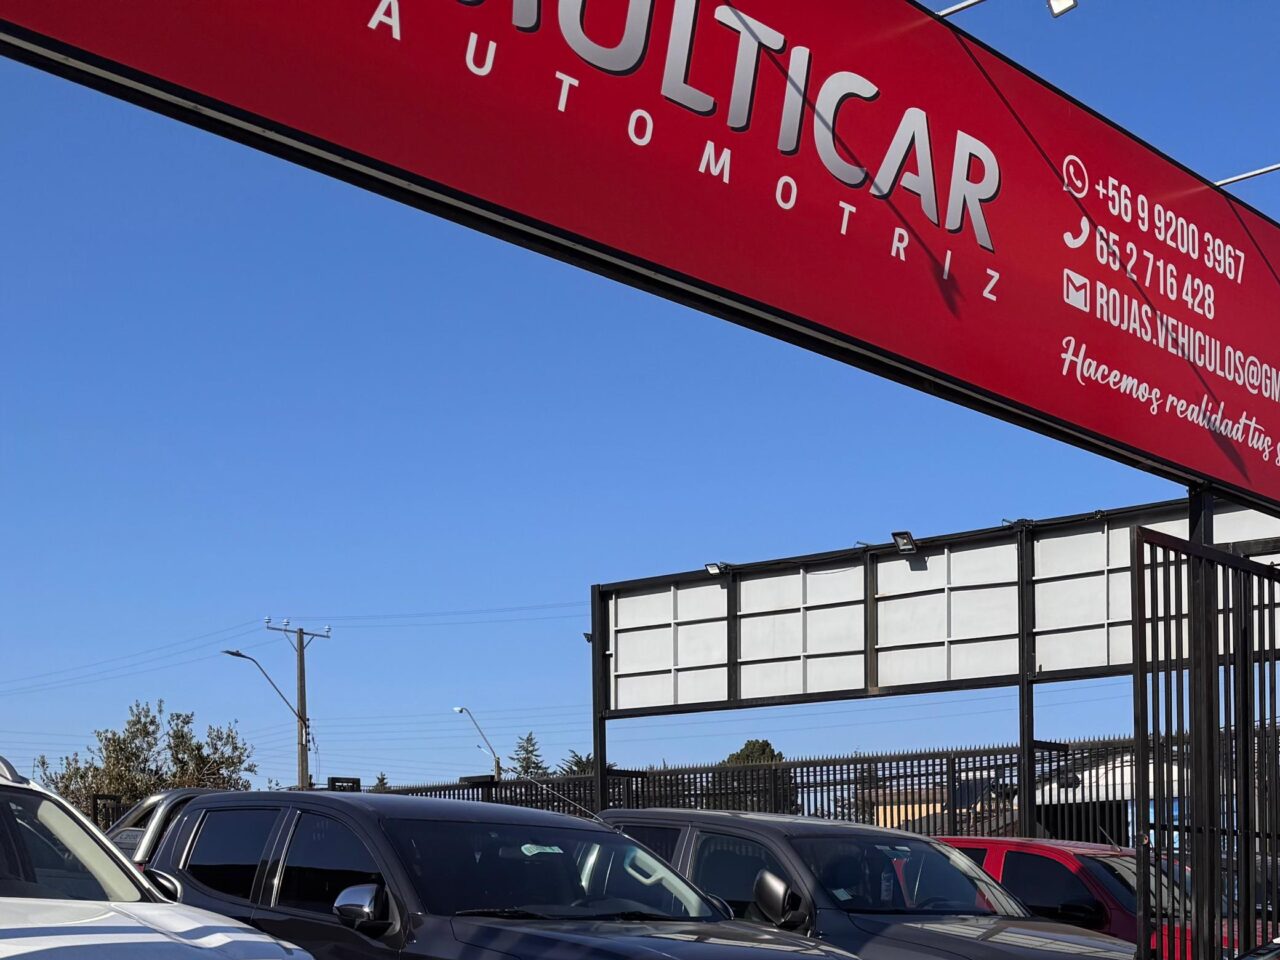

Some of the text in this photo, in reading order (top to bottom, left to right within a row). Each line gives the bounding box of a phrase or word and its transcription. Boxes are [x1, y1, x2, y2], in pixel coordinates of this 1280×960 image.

[367, 0, 1000, 300] AUTOMOTRIZ
[511, 0, 999, 252] ULTICAR
[1095, 176, 1245, 284] +56 9 9200 3967
[1095, 225, 1120, 271] 65
[1126, 242, 1137, 280] 2
[1182, 273, 1215, 320] 428
[1061, 336, 1164, 415] Hacemos
[1166, 394, 1248, 442] realidad
[1243, 412, 1273, 461] tus
